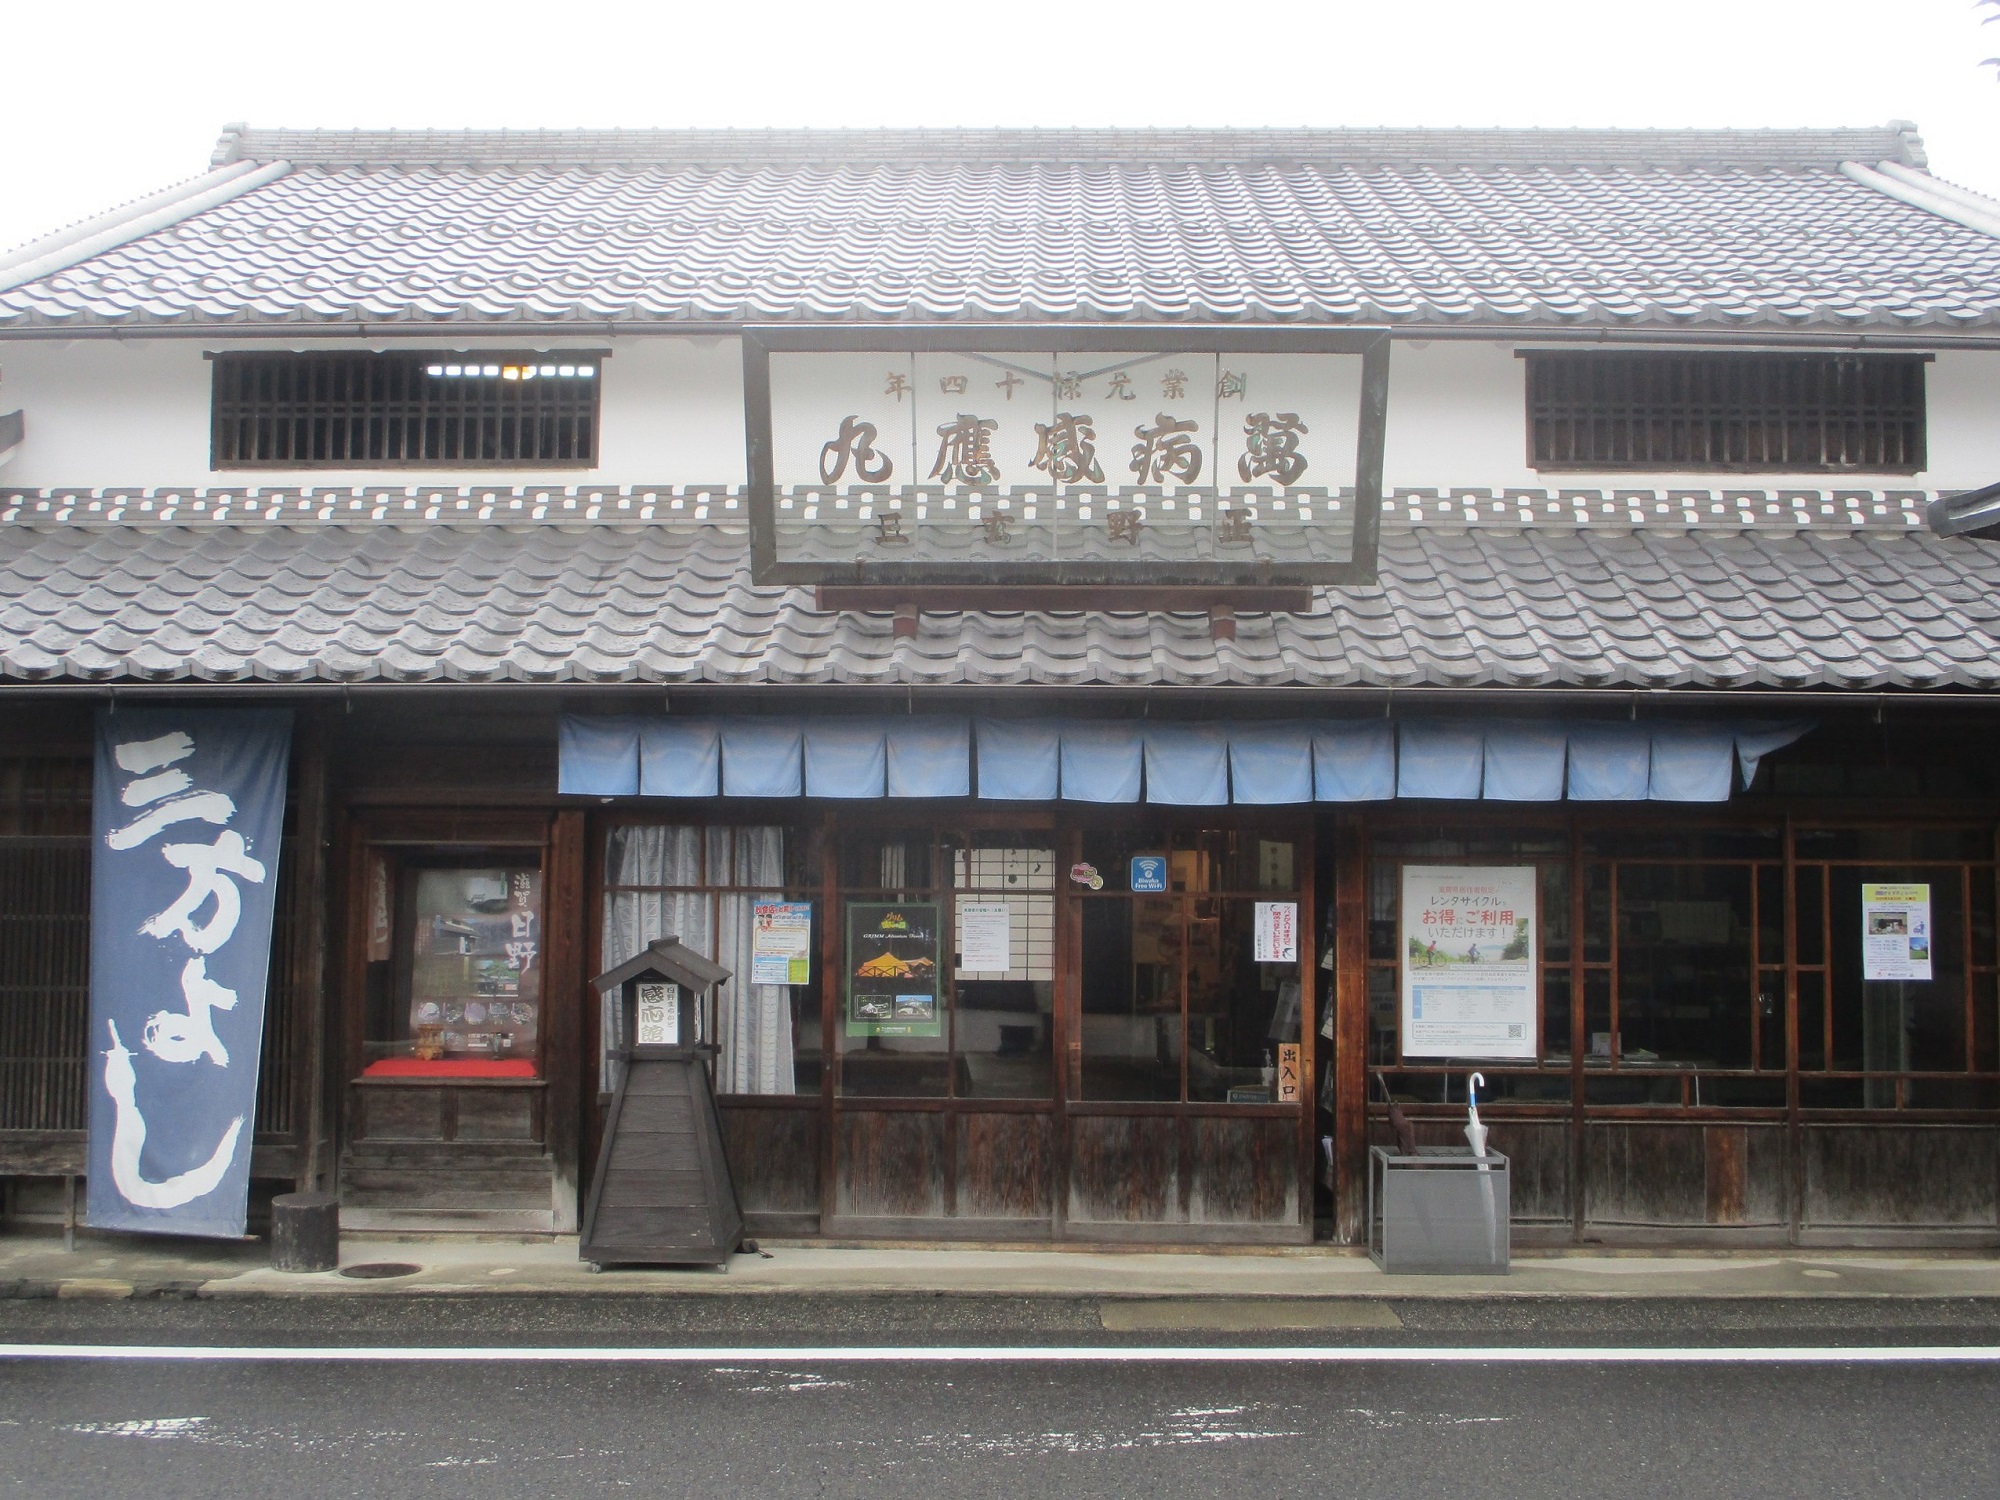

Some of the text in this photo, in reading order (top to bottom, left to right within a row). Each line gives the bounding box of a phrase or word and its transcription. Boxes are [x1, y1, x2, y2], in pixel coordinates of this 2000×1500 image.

[505, 910, 538, 975] 日野
[1422, 908, 1514, 926] お得にご利用
[101, 731, 266, 1209] 三方よし
[1282, 1048, 1297, 1095] 出入口
